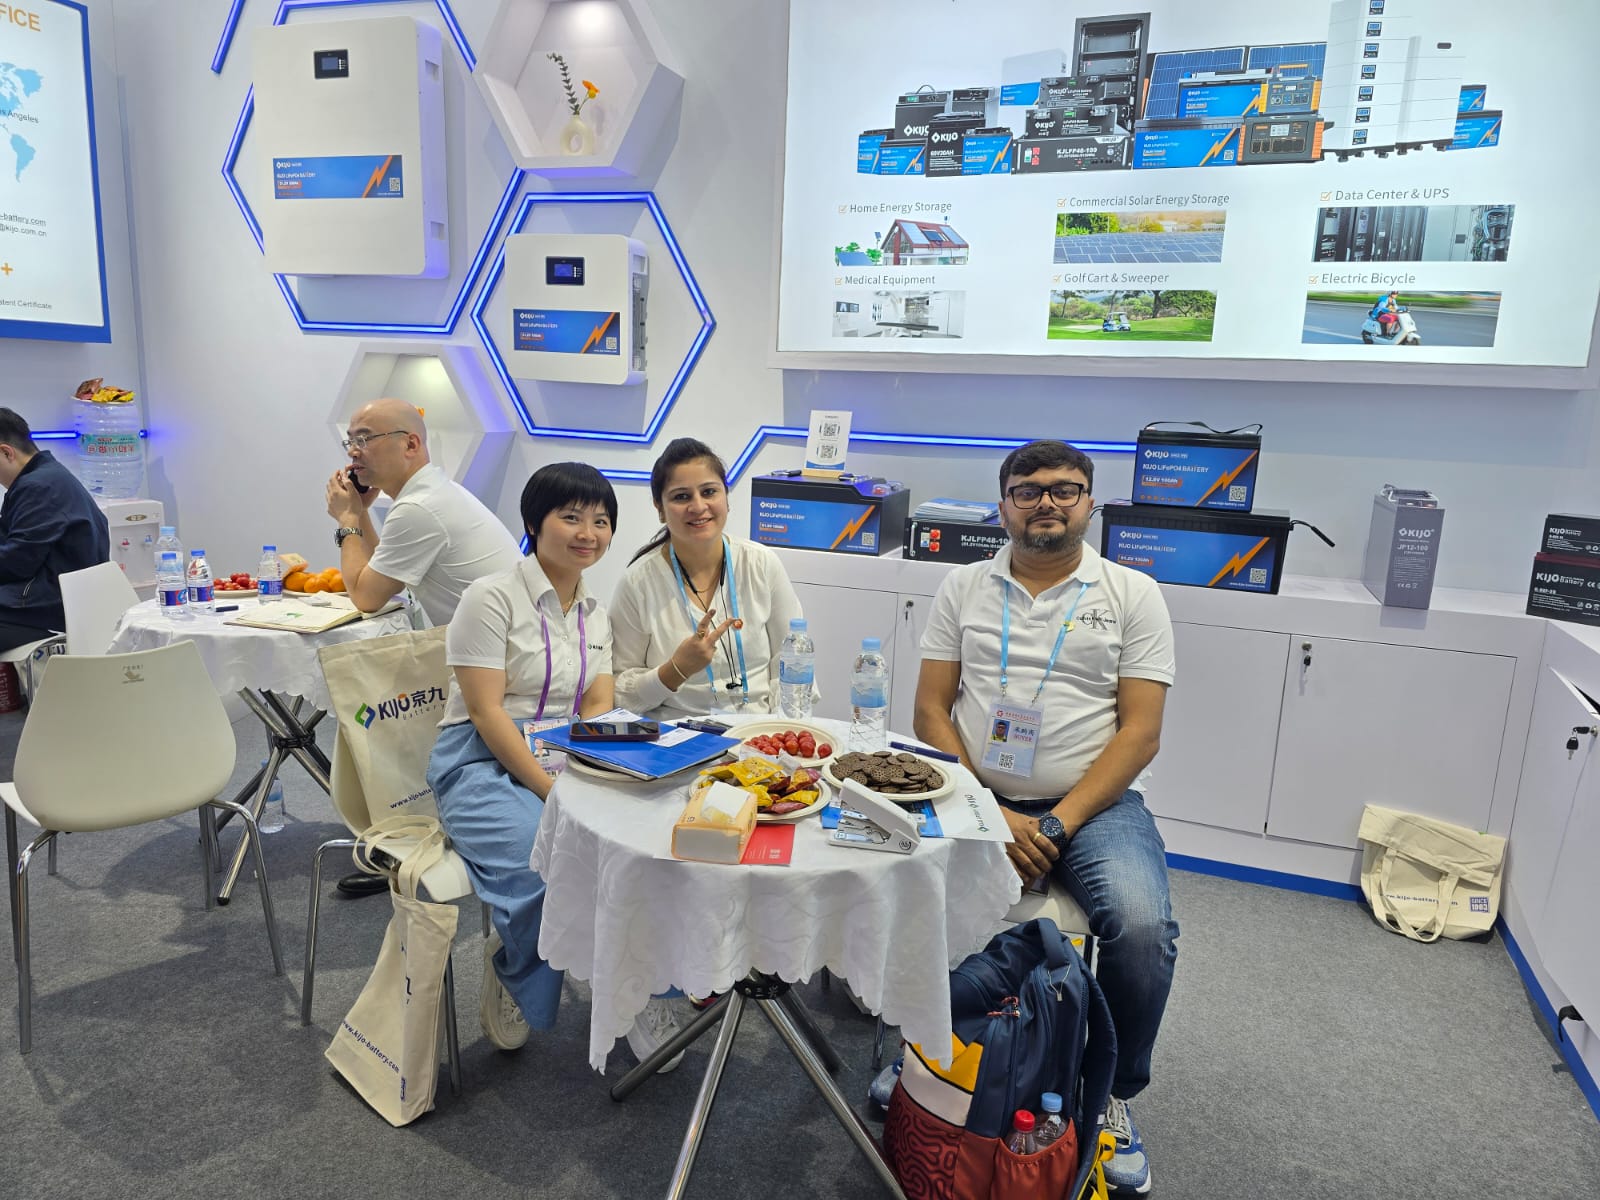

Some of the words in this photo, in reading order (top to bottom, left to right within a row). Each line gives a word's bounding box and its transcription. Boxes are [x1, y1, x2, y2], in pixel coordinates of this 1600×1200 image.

[8, 110, 39, 123] Angeles
[940, 132, 958, 142] KIJO
[1070, 196, 1127, 207] Commercial
[1129, 195, 1154, 206] Solar
[1156, 194, 1190, 207] Energy
[1192, 193, 1230, 206] Storage
[1335, 190, 1363, 201] Data
[1366, 188, 1409, 200] Center
[1411, 189, 1420, 199] &
[1423, 188, 1450, 199] UPS
[850, 204, 878, 213] Home
[880, 203, 913, 215] Energy
[915, 202, 952, 213] Storage
[845, 275, 881, 285] Medical
[883, 276, 935, 287] Equipment
[1064, 273, 1086, 284] Golf
[1087, 273, 1109, 284] Cart
[1111, 273, 1119, 283] &
[1121, 273, 1169, 285] Sweeper
[1321, 273, 1368, 284] Electric
[1370, 272, 1416, 286] Bicycle
[18, 300, 52, 310] Certificate
[1152, 451, 1169, 459] KIJO
[1408, 529, 1431, 538] KIJO
[1550, 527, 1565, 535] KIJO
[1536, 572, 1560, 583] KIJO
[378, 692, 410, 720] KIJO
[410, 686, 446, 708] 京九
